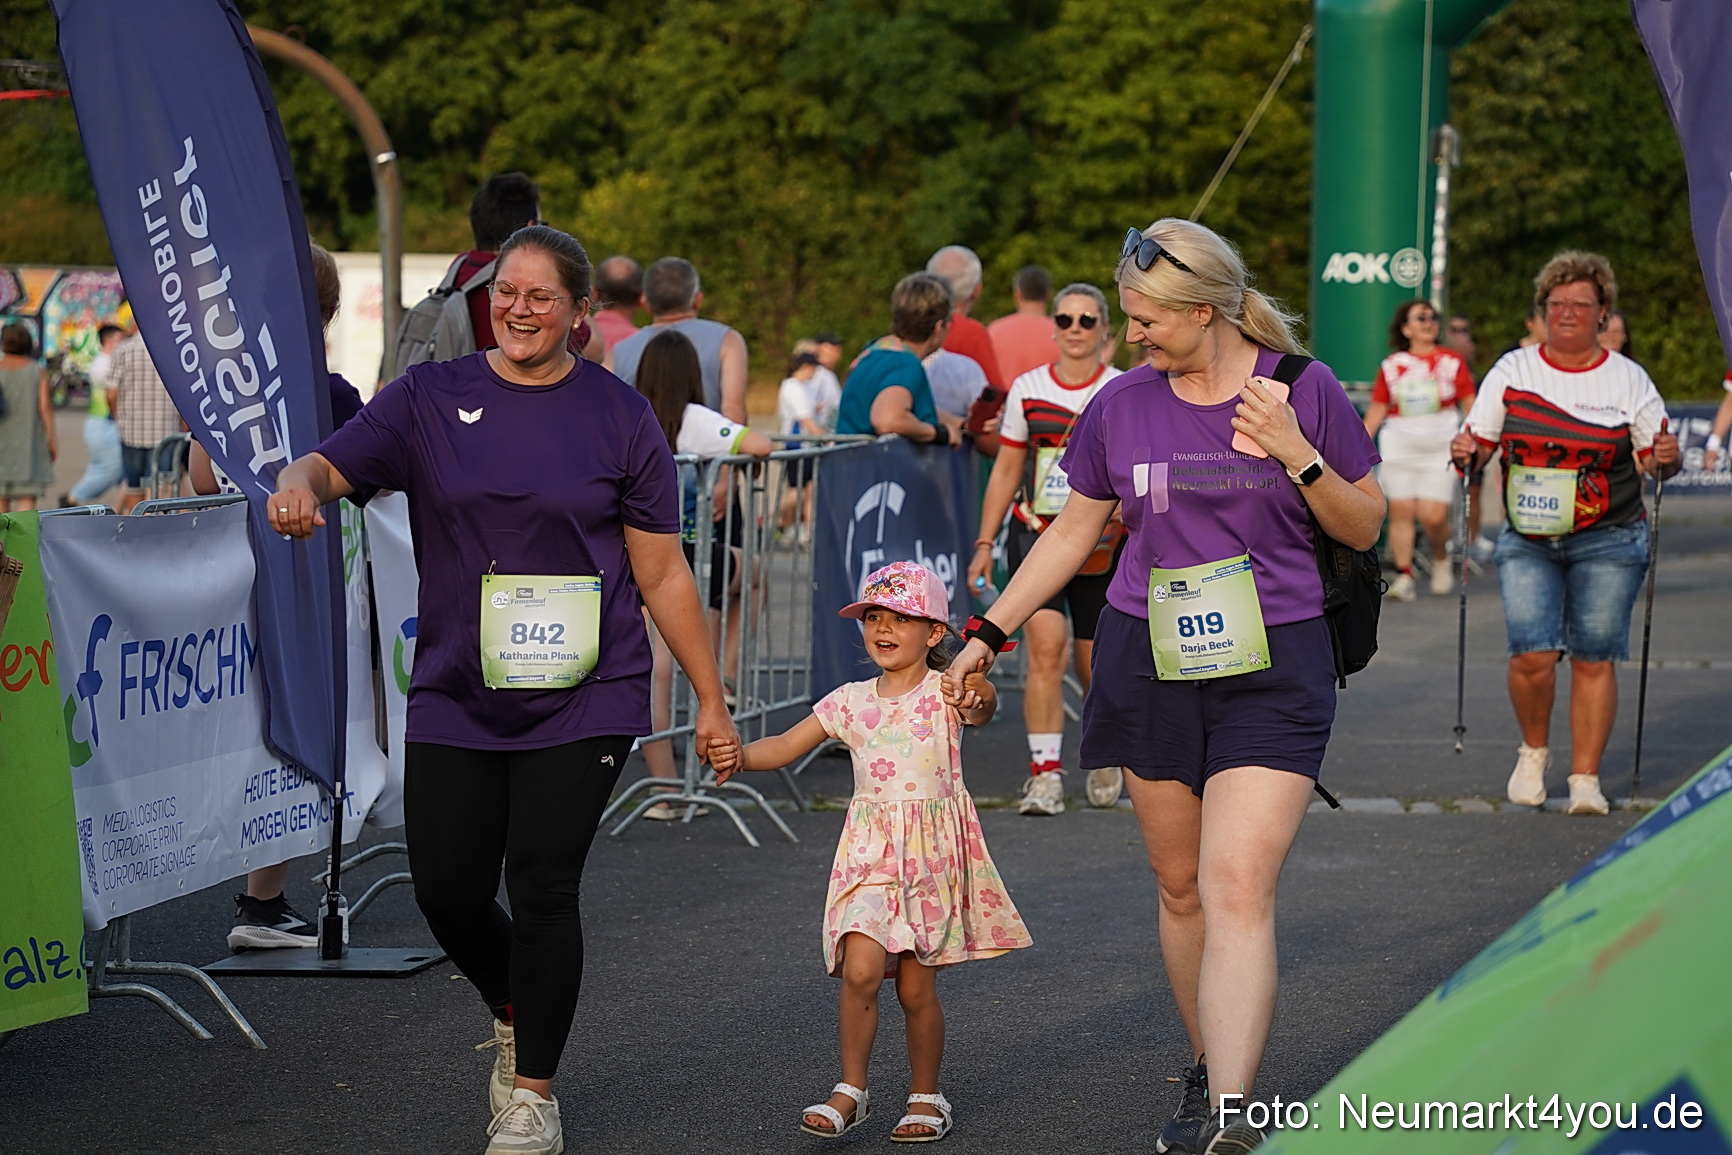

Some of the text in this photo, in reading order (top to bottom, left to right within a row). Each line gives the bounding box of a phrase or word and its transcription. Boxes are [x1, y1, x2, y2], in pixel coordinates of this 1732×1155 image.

[1322, 252, 1390, 284] AOK
[1172, 463, 1265, 477] Dekanatsbezirk
[1172, 478, 1231, 491] Neumarkt
[1517, 493, 1559, 510] 2656
[510, 622, 565, 645] 842
[1177, 611, 1225, 638] 819
[499, 650, 580, 661] Katharina Plank
[1180, 642, 1207, 654] Darja
[1208, 639, 1235, 650] Beck
[243, 768, 277, 805] HEUTE
[135, 796, 176, 828] LOGISTICS
[240, 807, 288, 849] MORGEN
[101, 821, 184, 863] CORPORATE PRINT
[103, 844, 196, 891] CORPORATE SIGNAGE
